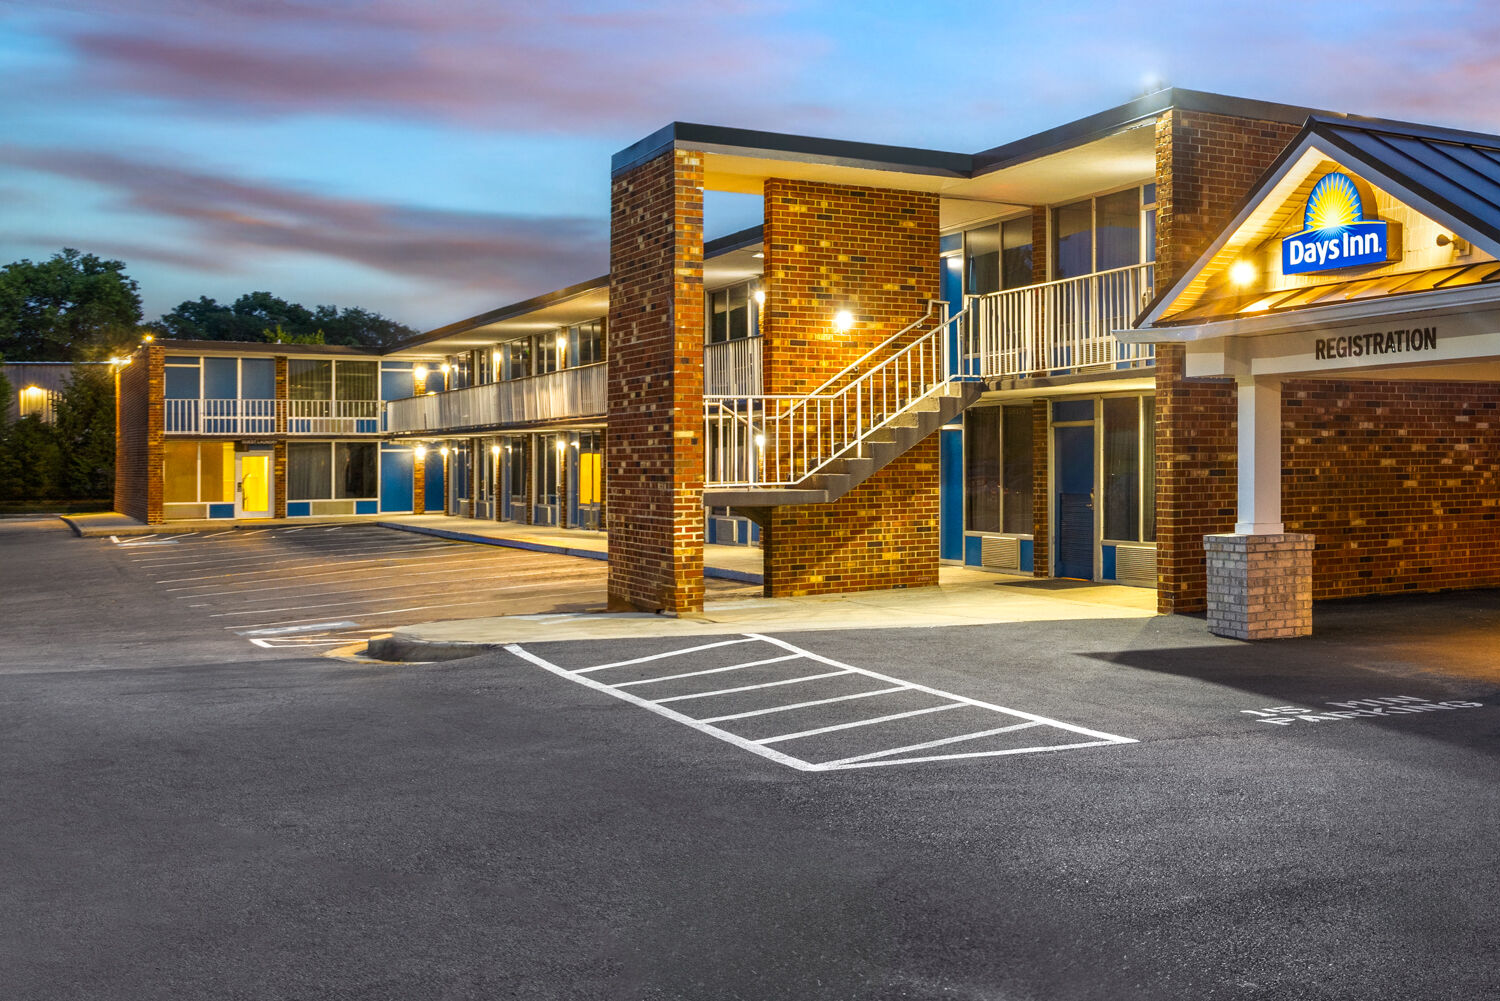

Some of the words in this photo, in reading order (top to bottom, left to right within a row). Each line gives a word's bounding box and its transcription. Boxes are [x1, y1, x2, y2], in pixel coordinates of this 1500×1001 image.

[1289, 238, 1340, 266] Days
[1342, 232, 1380, 258] Inn
[1315, 327, 1437, 360] REGISTRATION
[1240, 705, 1312, 717] 15
[1325, 695, 1430, 709] MIN
[1256, 700, 1483, 725] PARKING
